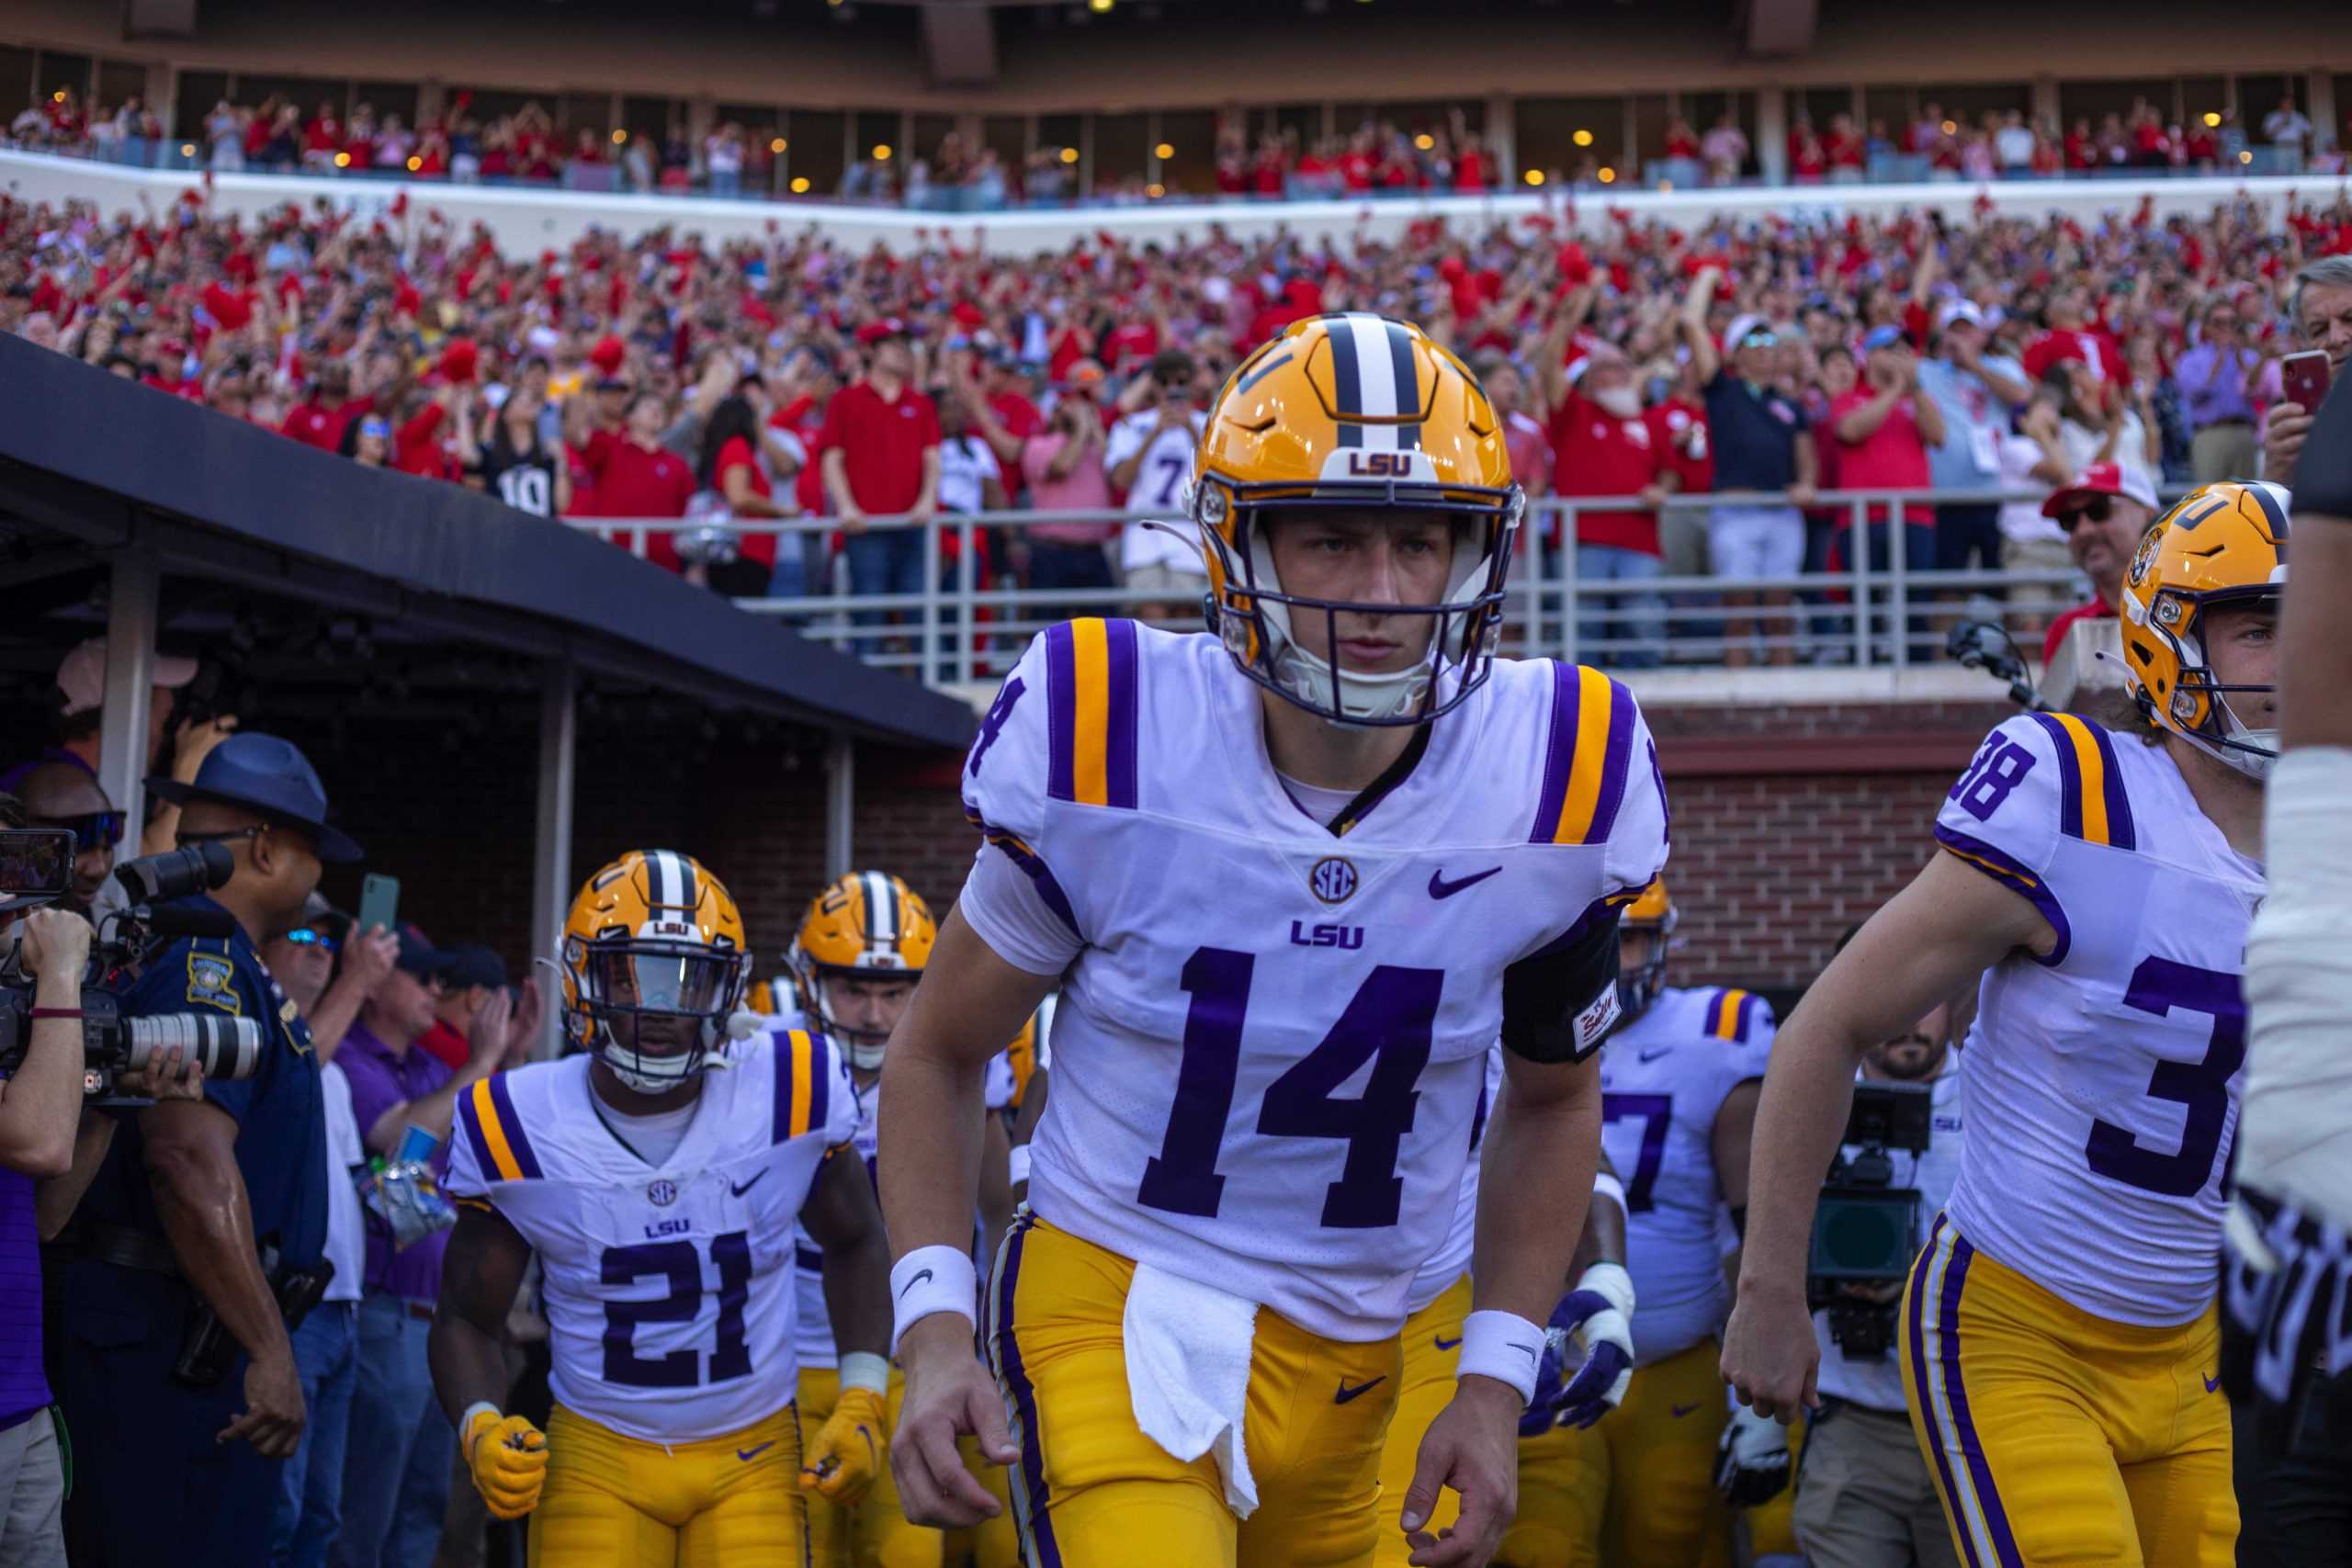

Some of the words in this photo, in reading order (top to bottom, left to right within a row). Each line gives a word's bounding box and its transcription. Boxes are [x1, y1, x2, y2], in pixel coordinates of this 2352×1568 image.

[1349, 452, 1411, 477] LSU
[497, 468, 550, 518] 10
[1948, 729, 2037, 823] 38
[1314, 859, 1356, 901] SEC
[653, 920, 689, 936] LSU
[1290, 919, 1364, 951] LSU
[1137, 945, 1446, 1229] 14
[2085, 954, 2248, 1202] 3
[1934, 1117, 1962, 1133] SU
[645, 1219, 690, 1239] LSU
[600, 1230, 754, 1388] 21
